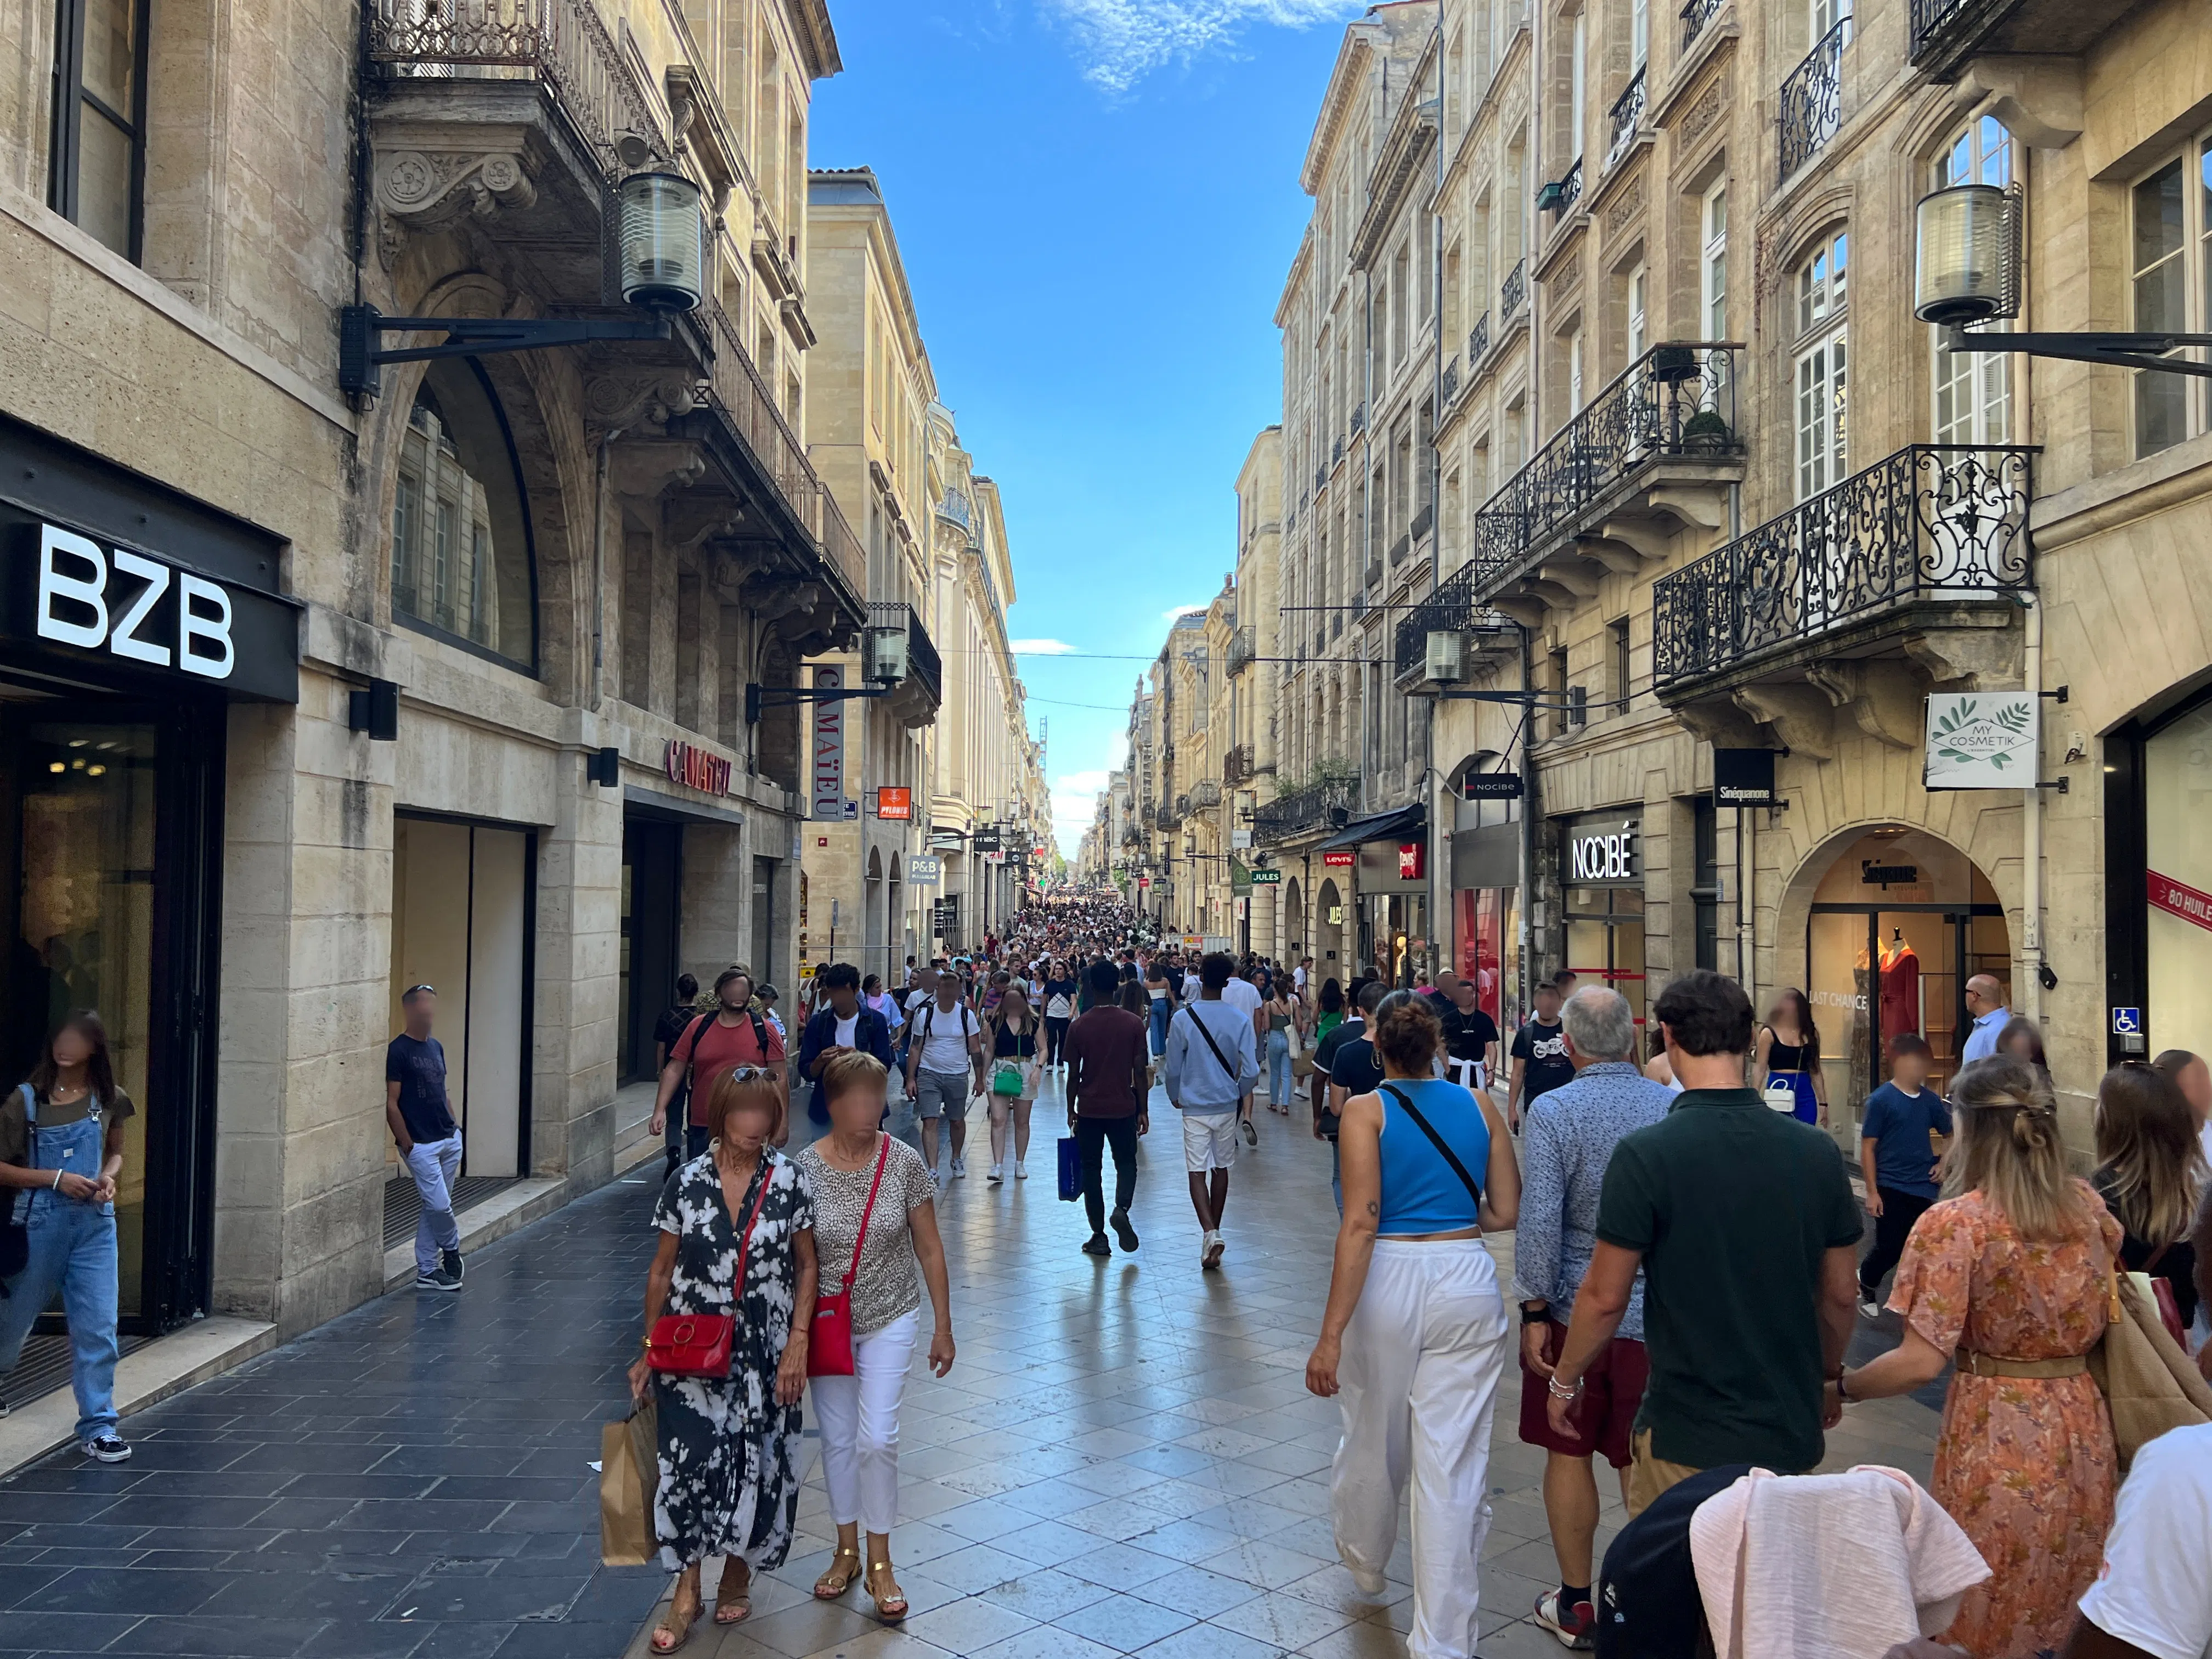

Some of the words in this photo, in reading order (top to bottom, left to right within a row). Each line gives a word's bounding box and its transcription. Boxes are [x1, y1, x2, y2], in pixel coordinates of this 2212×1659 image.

[37, 523, 234, 679] BZB
[1972, 726, 1992, 735] MY
[1950, 737, 2015, 746] COSMETIK
[1572, 820, 1630, 879] NOCIBÉ
[912, 860, 936, 873] P&B
[2168, 889, 2183, 907] 80
[2183, 895, 2212, 921] HUILE
[1809, 990, 1828, 1006] LAST
[1829, 992, 1867, 1010] CHANCE
